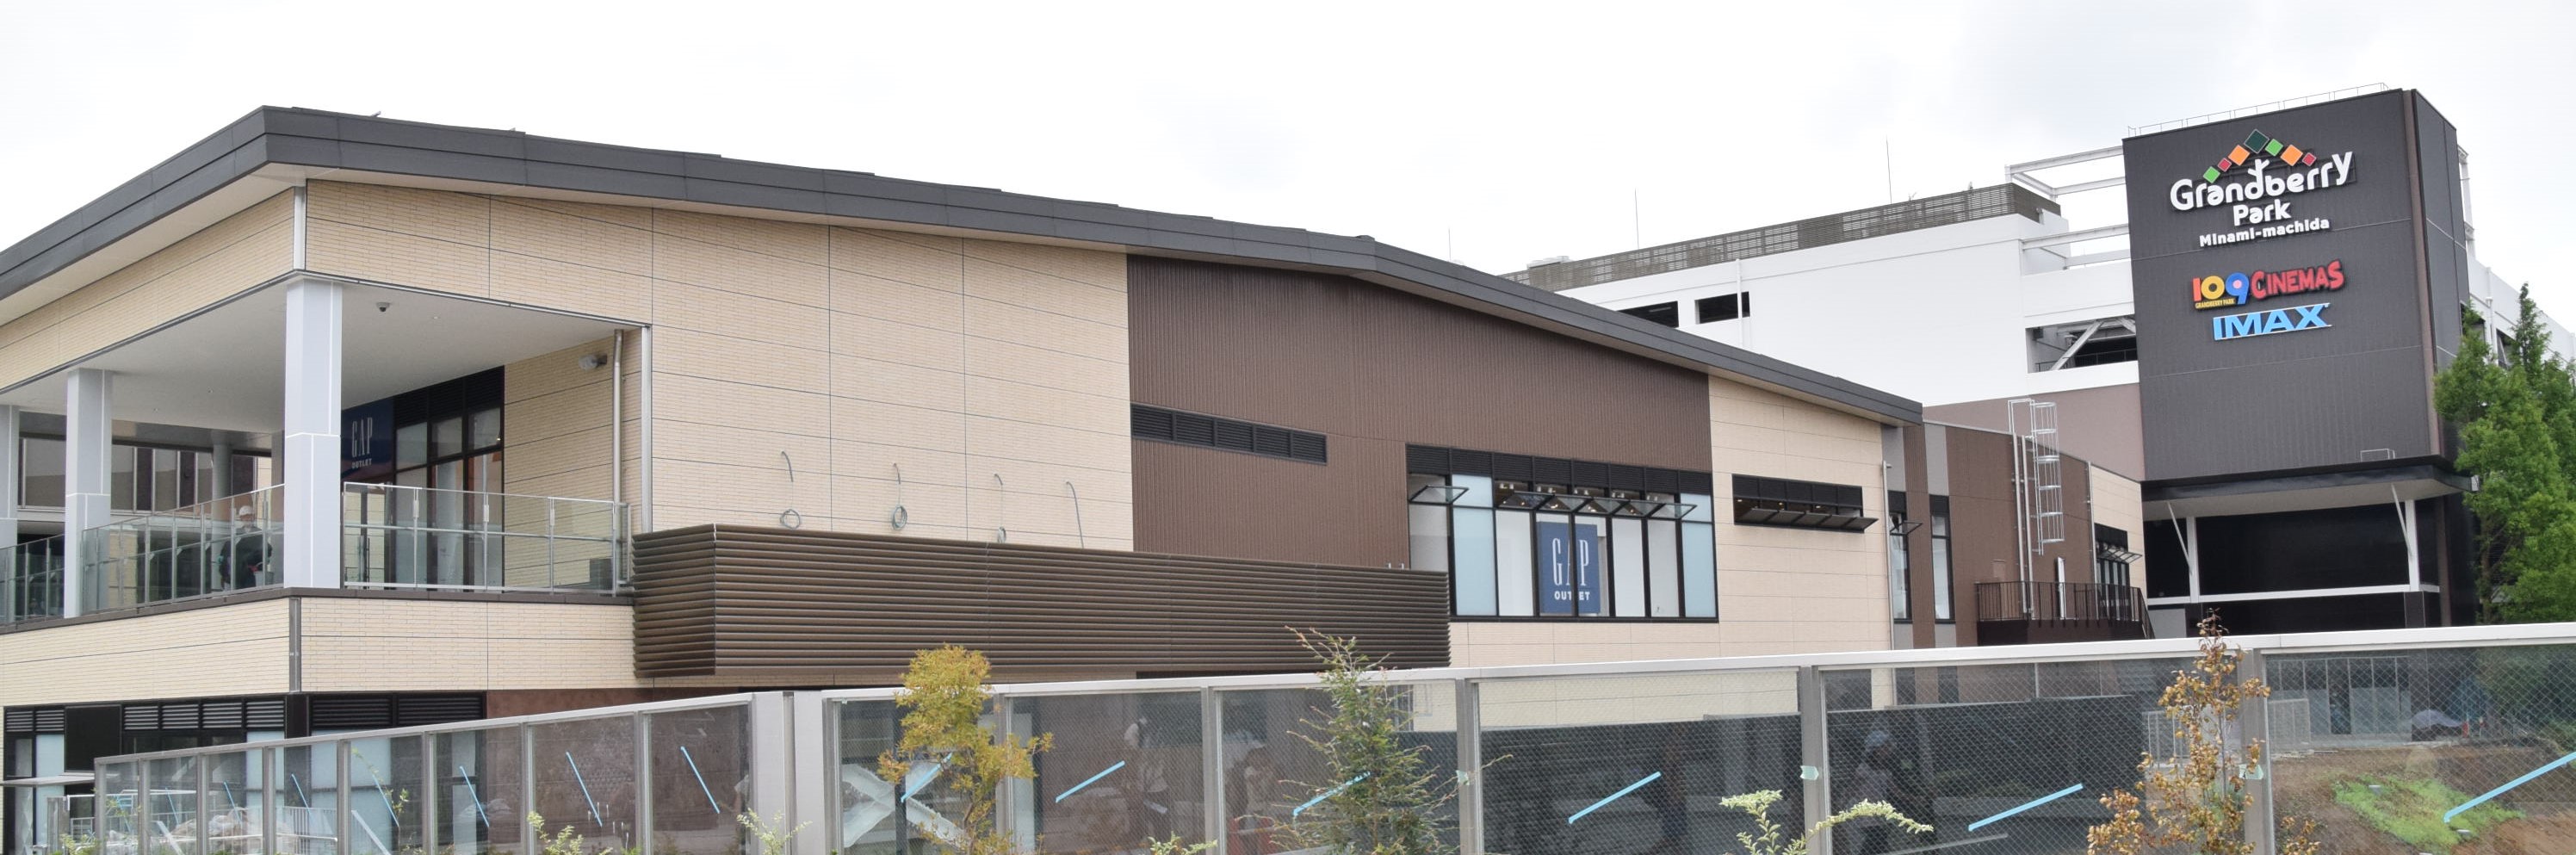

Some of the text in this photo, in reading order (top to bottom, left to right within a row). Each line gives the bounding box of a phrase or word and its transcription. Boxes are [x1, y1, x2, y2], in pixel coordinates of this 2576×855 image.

[2170, 152, 2353, 211] Grandberry
[2233, 199, 2292, 226] Park
[2199, 217, 2330, 247] Minami-machida
[2192, 258, 2345, 305] 109 CINEMAS
[2213, 303, 2332, 341] IMAX
[351, 417, 373, 458] GAP
[351, 458, 373, 469] OUTLET
[1554, 591, 1590, 601] OUTET
